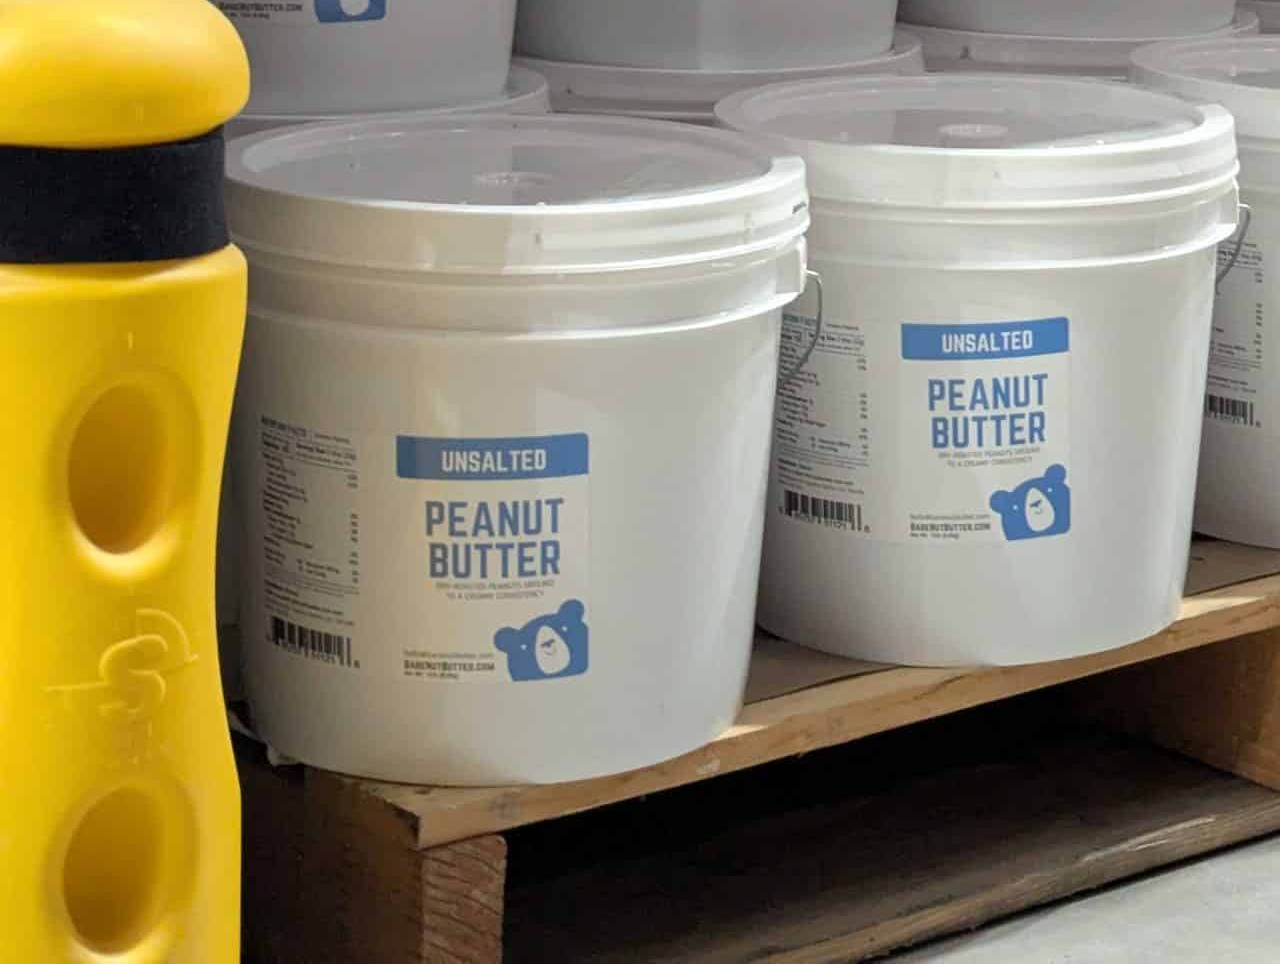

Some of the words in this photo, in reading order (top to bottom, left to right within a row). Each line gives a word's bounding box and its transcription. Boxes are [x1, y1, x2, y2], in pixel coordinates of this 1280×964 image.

[942, 330, 1033, 352] UNSALTED
[928, 373, 1048, 412] PEANUT
[931, 411, 1046, 449] BUTTER
[441, 449, 547, 472] UNSALTED
[425, 497, 564, 537] PEANUT
[429, 540, 561, 578] BUTTER
